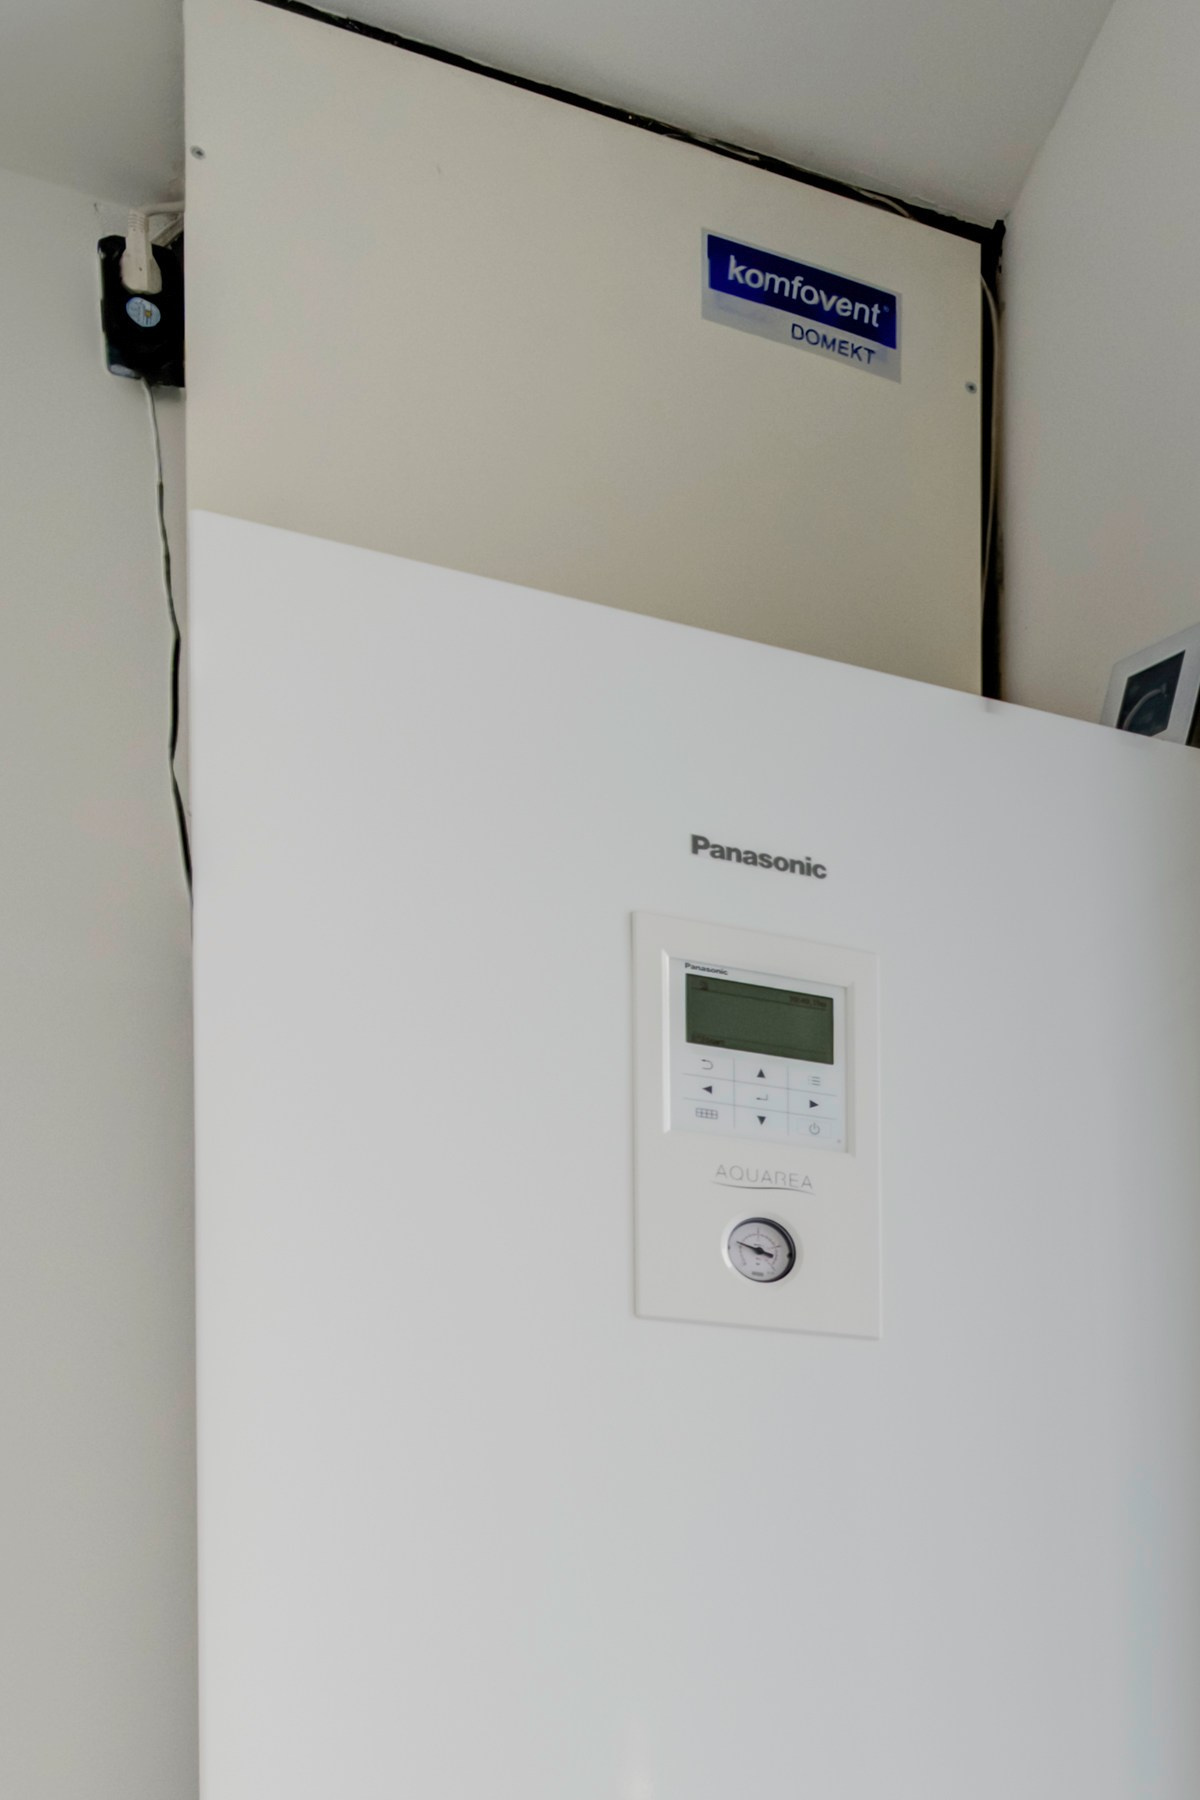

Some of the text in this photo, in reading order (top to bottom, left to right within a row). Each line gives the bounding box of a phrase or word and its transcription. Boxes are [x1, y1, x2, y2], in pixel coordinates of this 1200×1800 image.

[727, 254, 881, 328] komfovent
[791, 323, 876, 364] DOMEKT
[691, 834, 827, 879] Panasonic
[685, 962, 728, 975] Panasonic
[716, 1164, 812, 1189] AQUAREA
